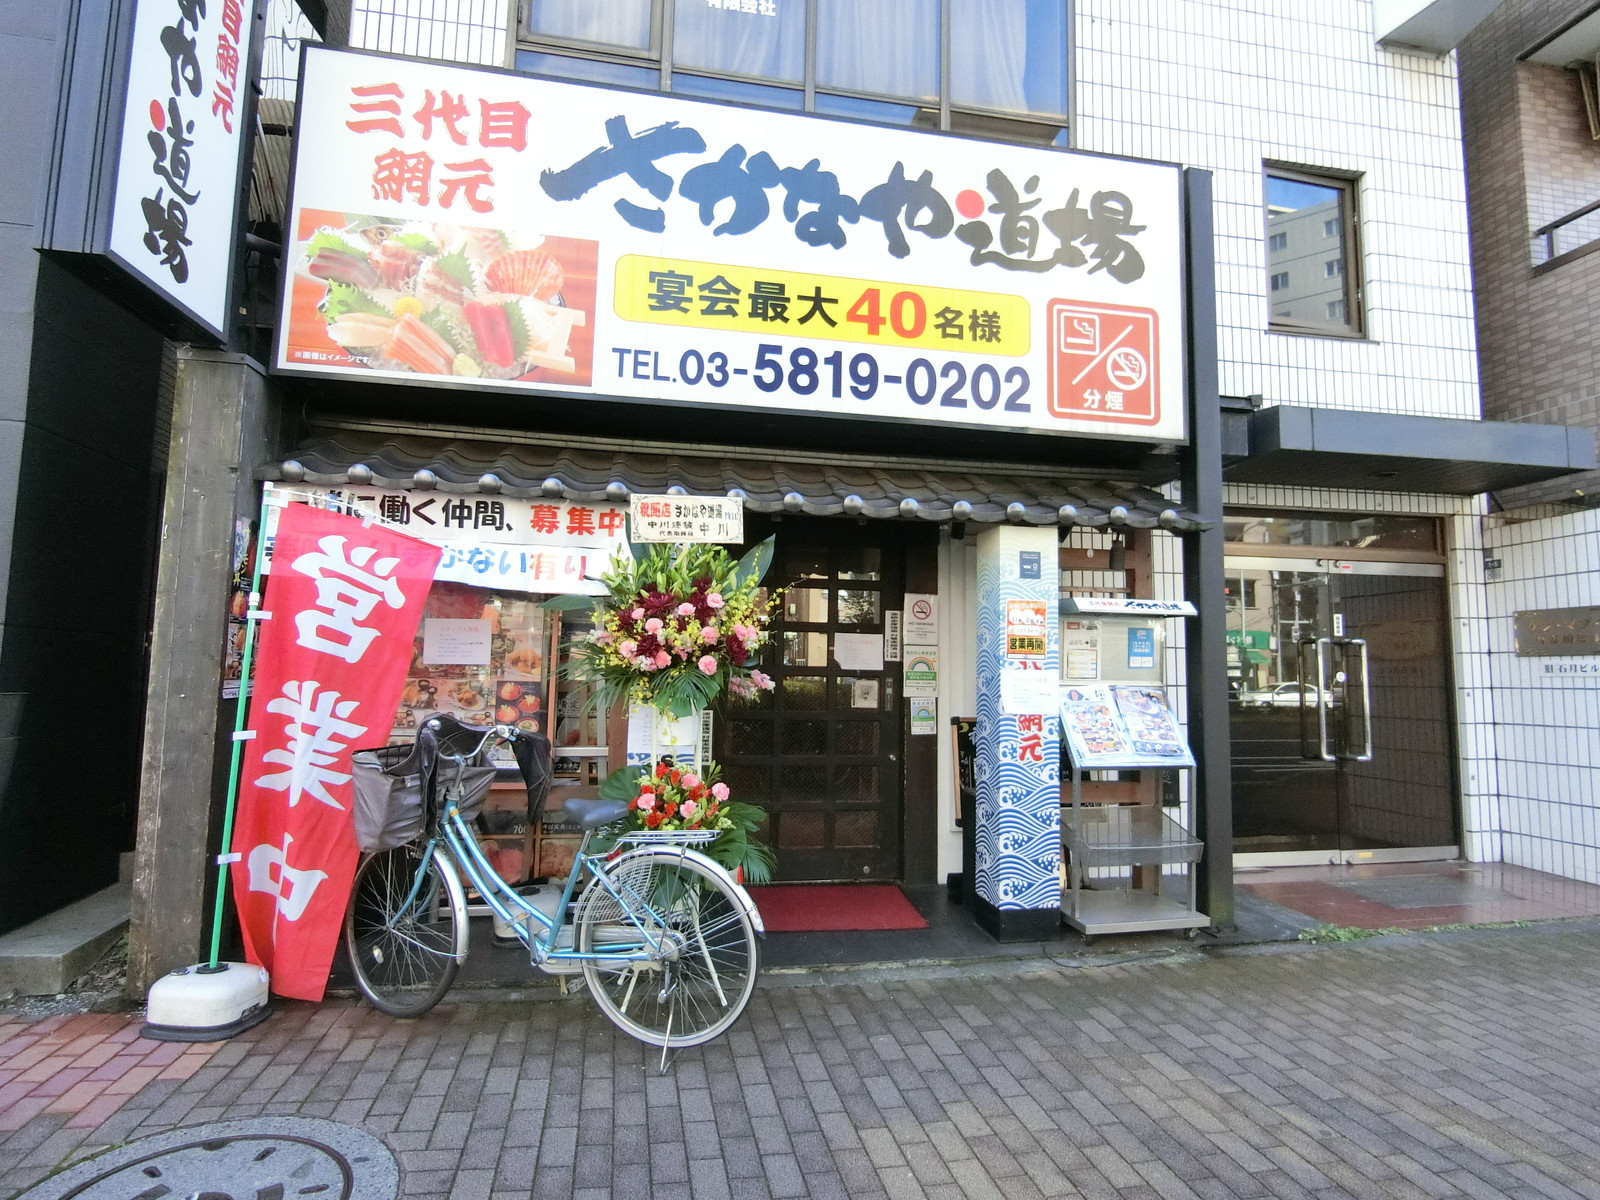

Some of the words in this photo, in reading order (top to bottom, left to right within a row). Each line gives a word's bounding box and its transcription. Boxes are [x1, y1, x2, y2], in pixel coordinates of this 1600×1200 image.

[211, 0, 245, 135] 目網元
[345, 82, 532, 153] 三代目
[371, 147, 495, 213] 網元
[538, 114, 1148, 284] さかなや道場
[647, 269, 1002, 343] 宴会最大40名様
[611, 343, 1032, 414] TEL.03-5819-0202
[1082, 388, 1125, 411] 分煙
[1009, 636, 1044, 651] 営業再開
[247, 534, 407, 923] 営業中
